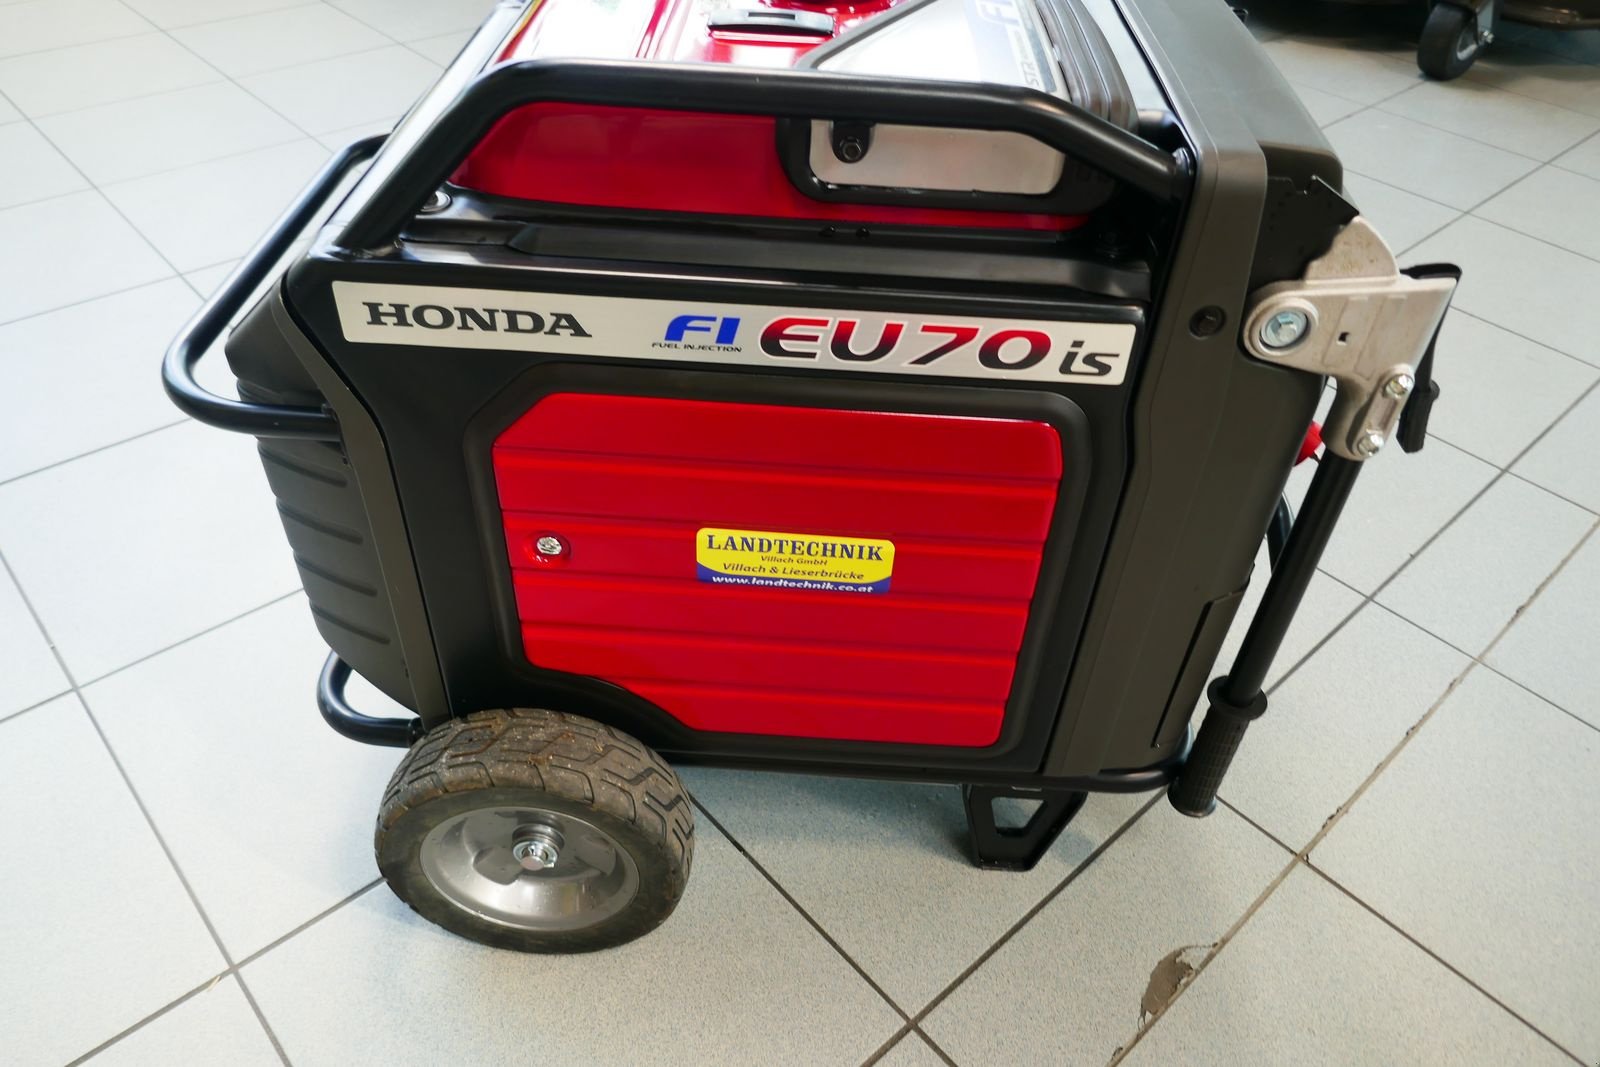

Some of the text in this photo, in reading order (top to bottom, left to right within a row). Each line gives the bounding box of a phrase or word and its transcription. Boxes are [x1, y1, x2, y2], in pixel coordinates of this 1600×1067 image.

[362, 301, 592, 338] HONDA
[664, 315, 740, 345] FI
[684, 343, 742, 352] INJECTION
[707, 534, 884, 561] LANDTECHNIK
[760, 555, 828, 566] Villach GmbH
[723, 562, 865, 581] Villach & Lieserbrücke
[711, 575, 874, 593] www.landtechnik.co.at
